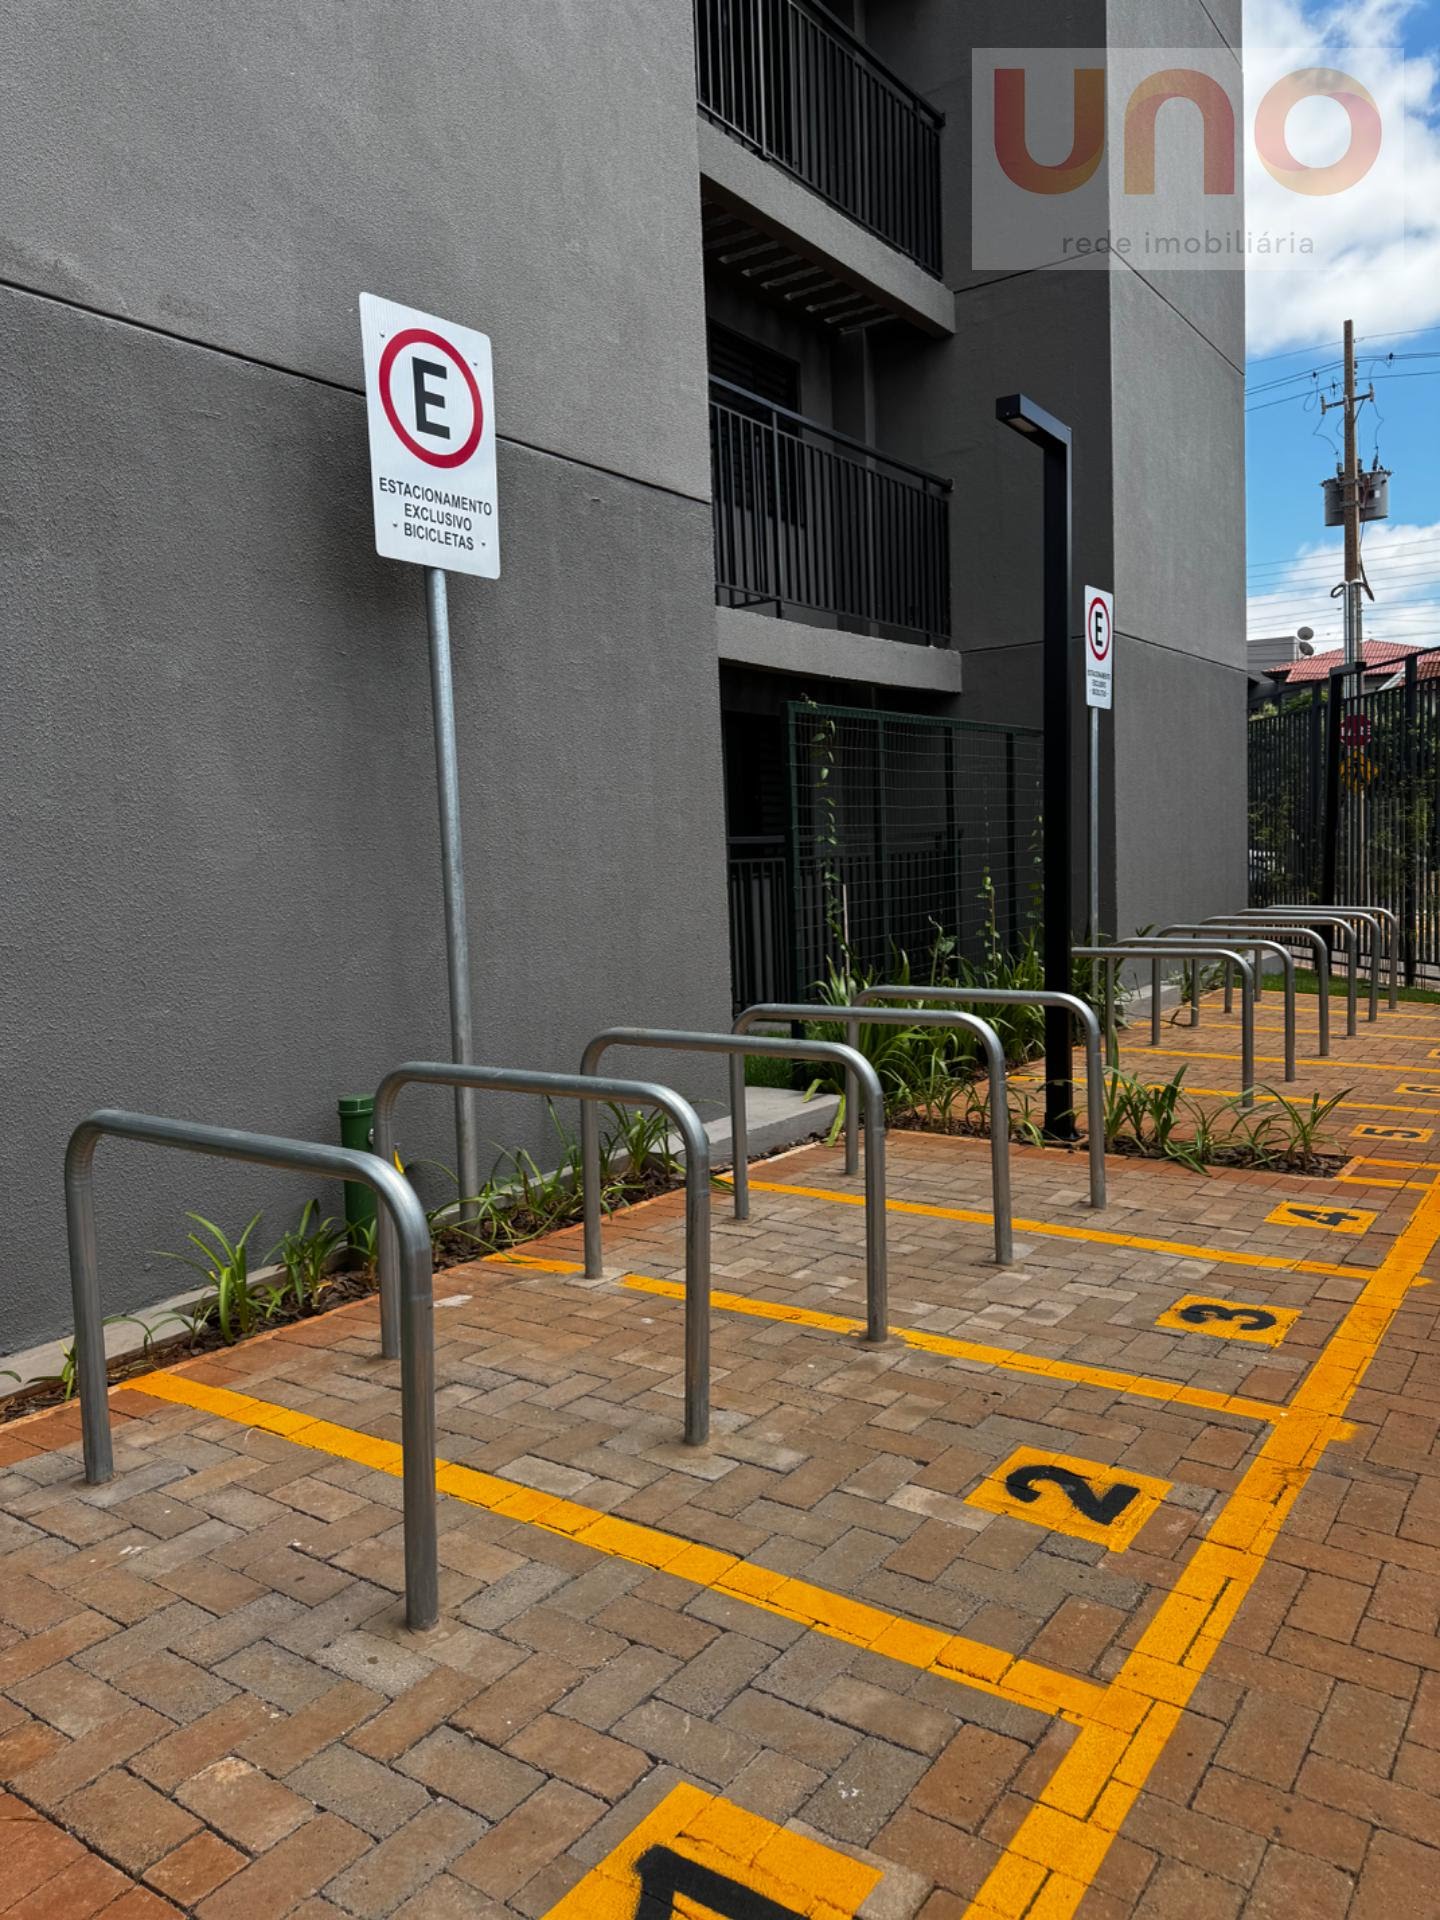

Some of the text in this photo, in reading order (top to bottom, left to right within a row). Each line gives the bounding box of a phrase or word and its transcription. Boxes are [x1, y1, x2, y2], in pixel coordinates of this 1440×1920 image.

[412, 356, 451, 440] E
[379, 477, 492, 516] ESTACIONAMENTO
[404, 503, 472, 531] EXCLUSIVO
[404, 522, 475, 551] BICICLETAS
[1095, 611, 1103, 647] E
[1361, 1126, 1420, 1139] 5
[1286, 1207, 1360, 1226] 4
[1179, 1303, 1277, 1331] 3
[1004, 1464, 1141, 1526] 2
